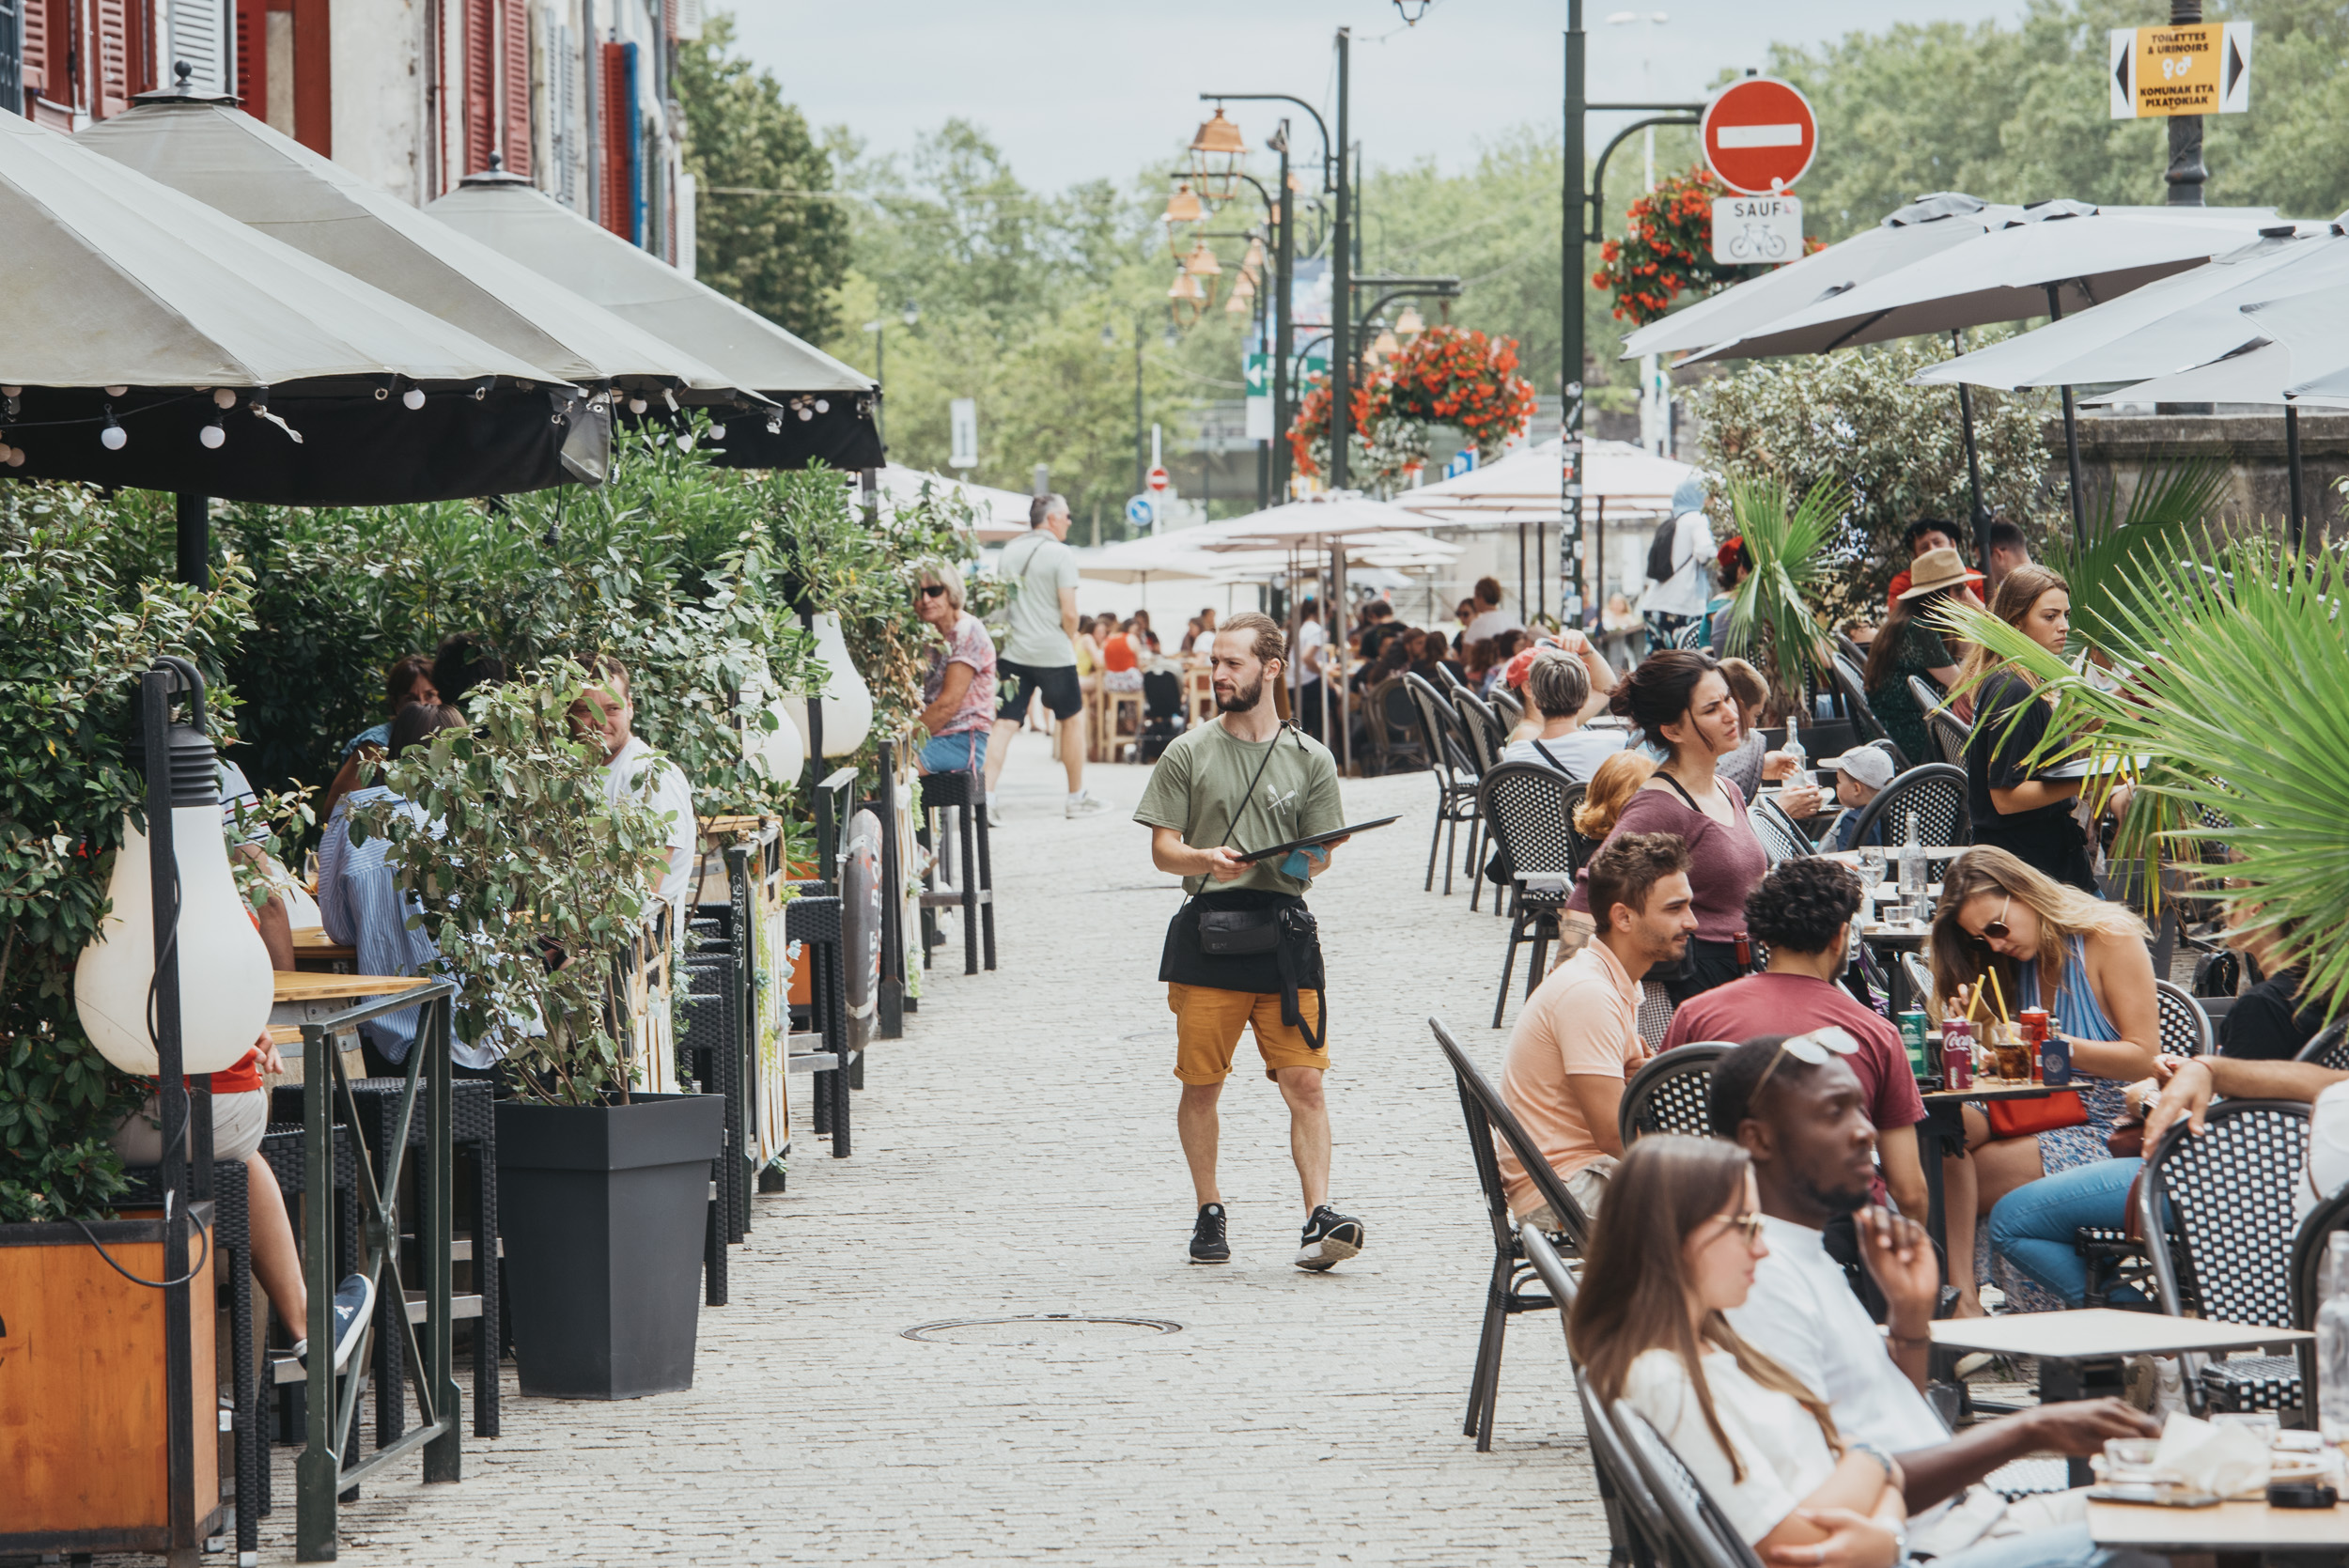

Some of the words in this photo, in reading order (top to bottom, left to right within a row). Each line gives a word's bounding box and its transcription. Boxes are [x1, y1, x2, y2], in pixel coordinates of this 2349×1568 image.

[2152, 32, 2206, 43] TOILETTES
[2148, 46, 2154, 54] &
[2157, 43, 2209, 54] URINOIRS
[2140, 85, 2191, 97] KOMUNAK
[2195, 84, 2214, 93] ETA
[2146, 96, 2208, 107] PIXATOKIAK
[1735, 202, 1781, 217] SAUF
